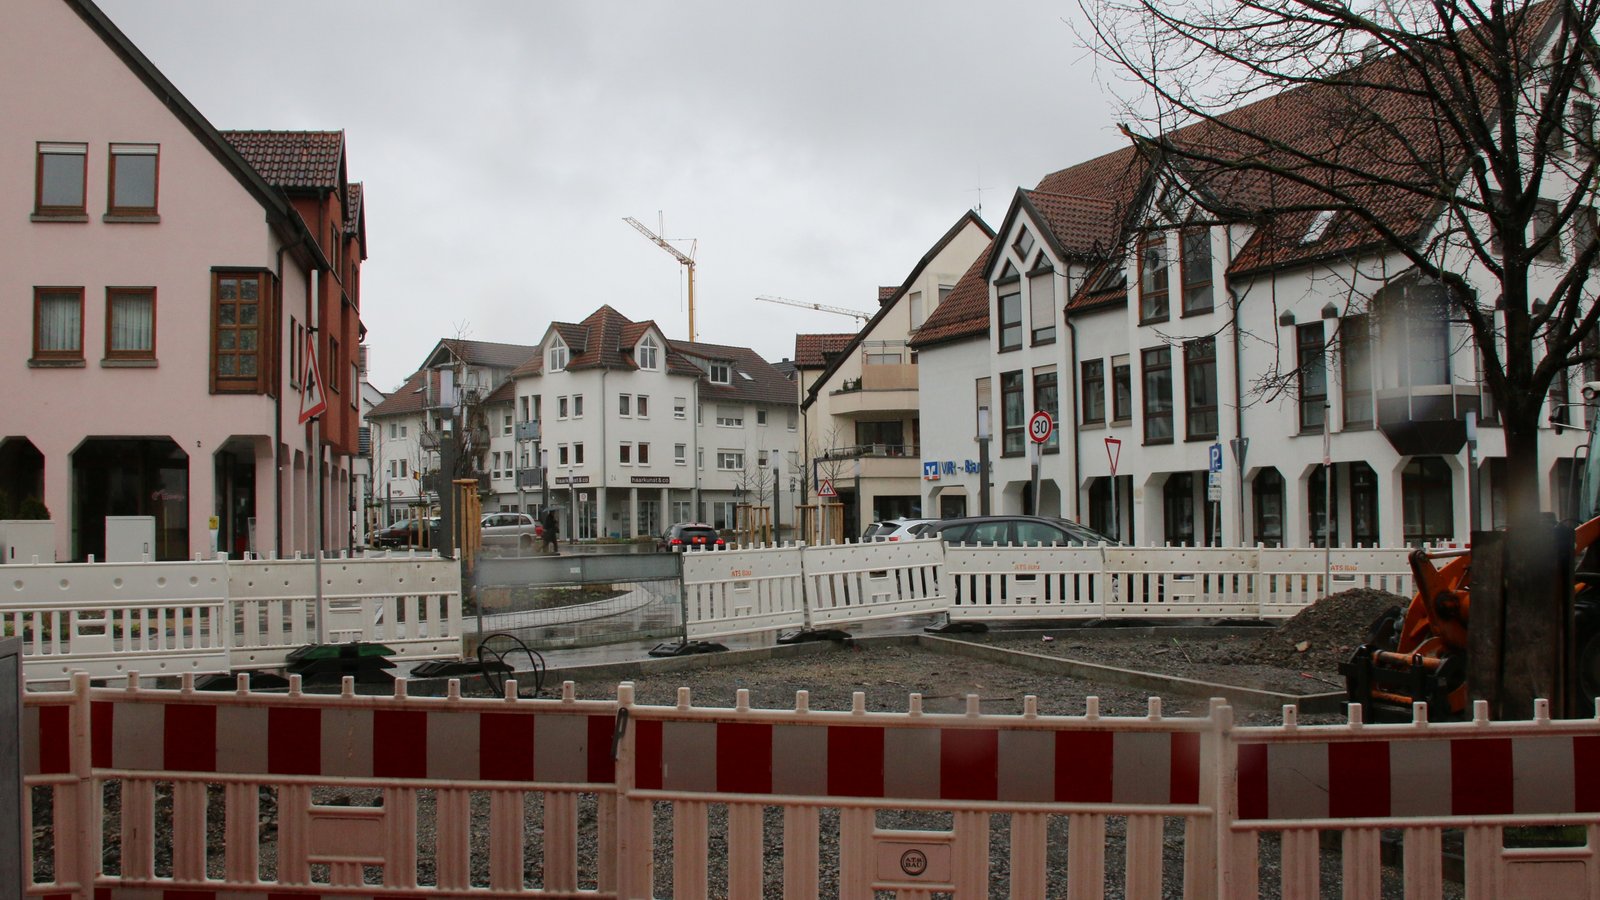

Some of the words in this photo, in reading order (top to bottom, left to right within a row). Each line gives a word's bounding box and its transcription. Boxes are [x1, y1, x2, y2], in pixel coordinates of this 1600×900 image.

[1034, 420, 1047, 434] 30
[196, 440, 202, 448] 2
[1212, 448, 1220, 468] P
